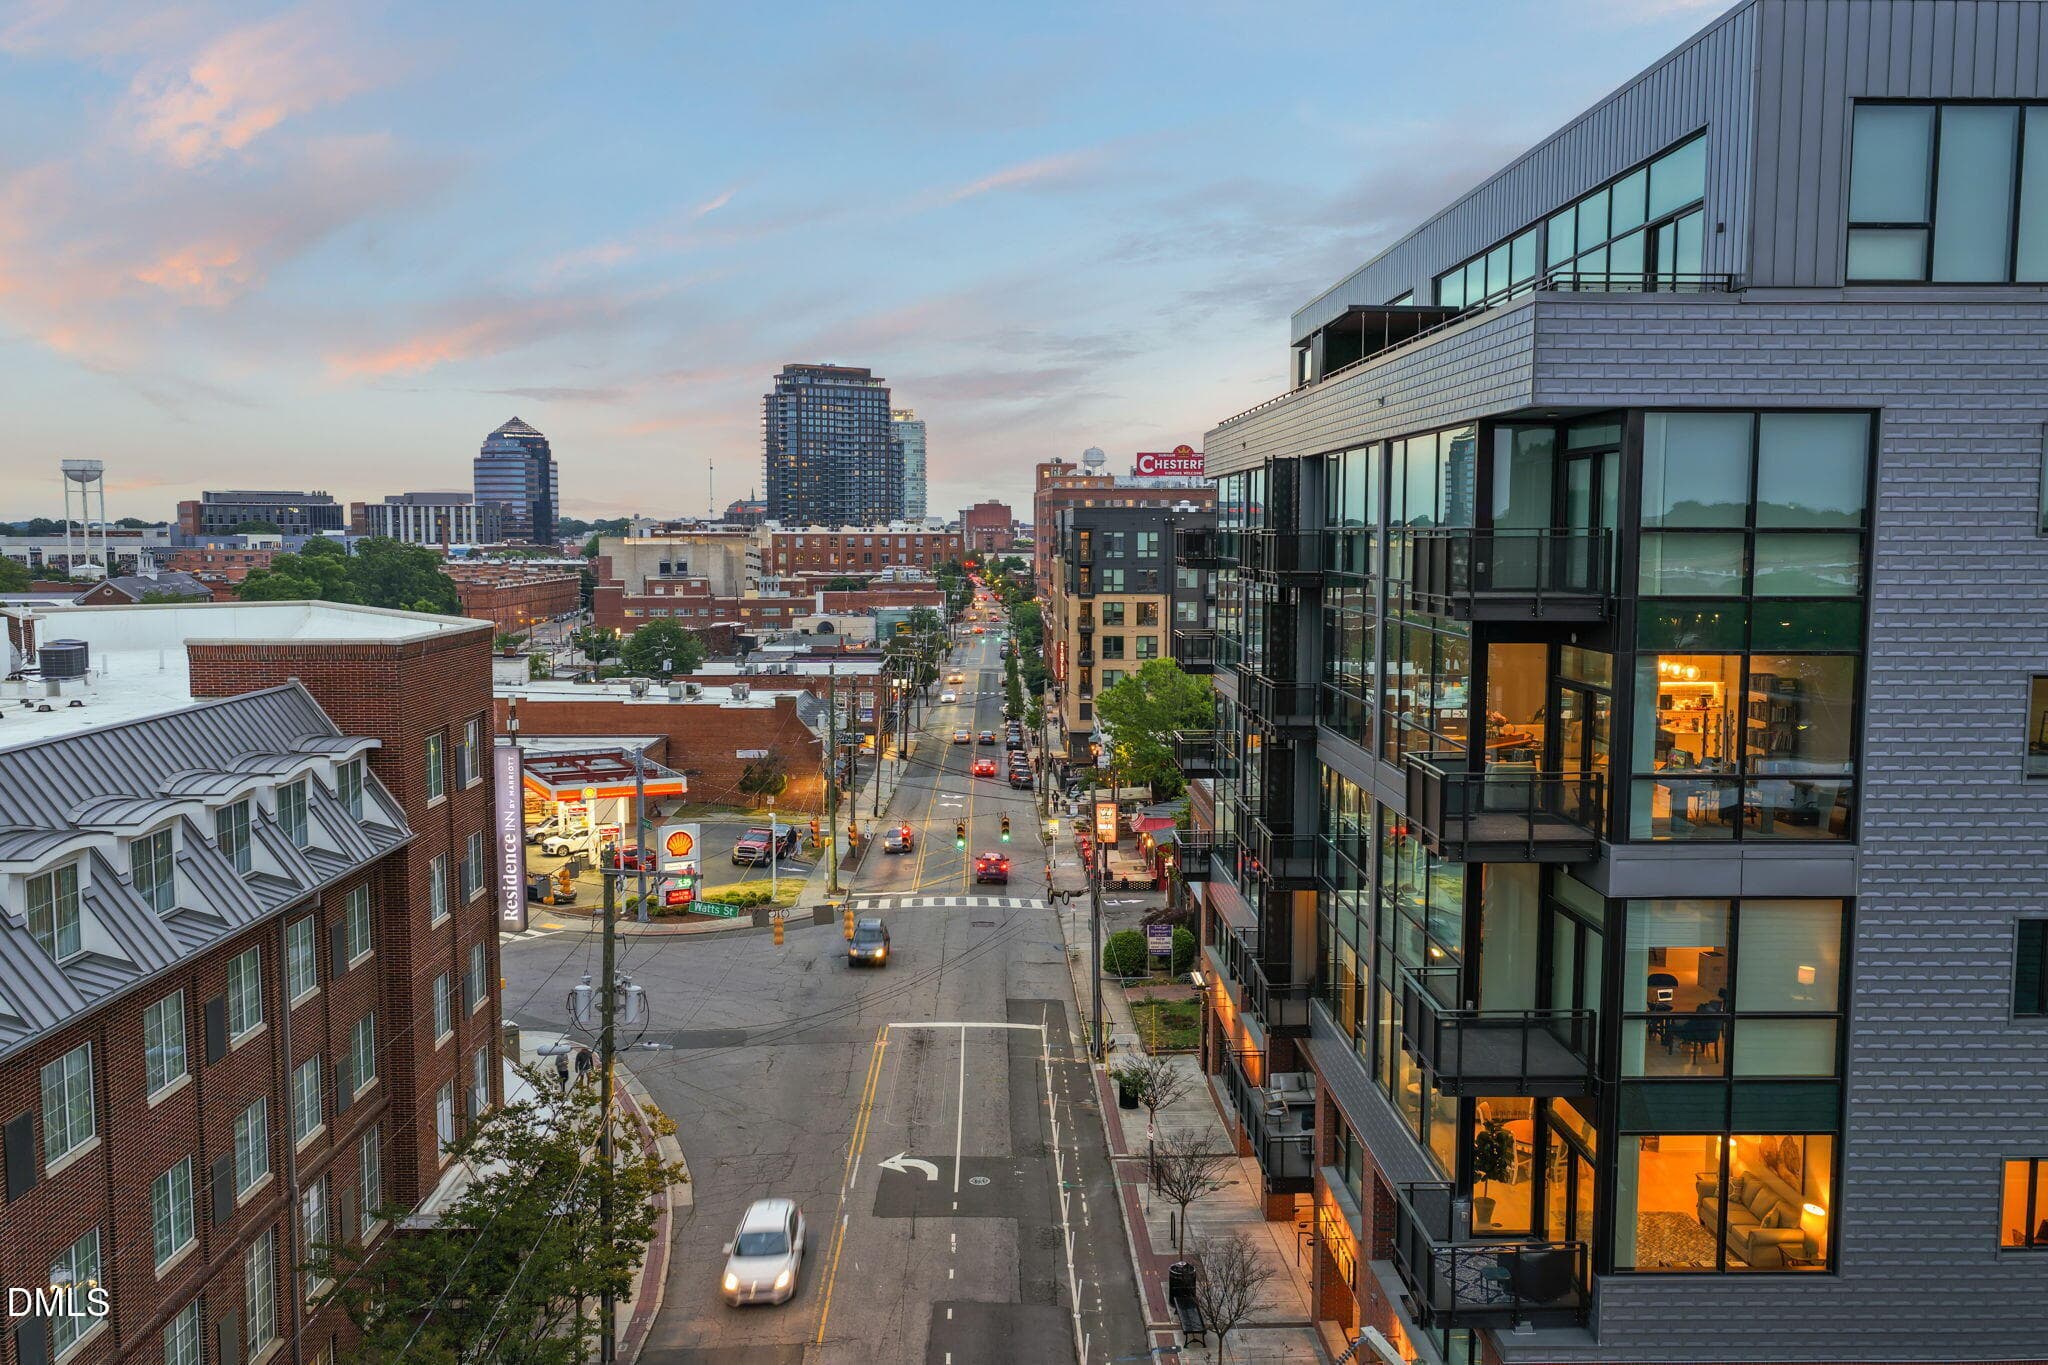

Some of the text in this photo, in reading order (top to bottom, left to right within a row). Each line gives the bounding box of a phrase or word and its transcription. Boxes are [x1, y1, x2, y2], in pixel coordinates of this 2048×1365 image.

[509, 800, 515, 809] BY
[504, 811, 515, 831] INN
[502, 834, 518, 921] Residence
[694, 902, 733, 915] Watts St
